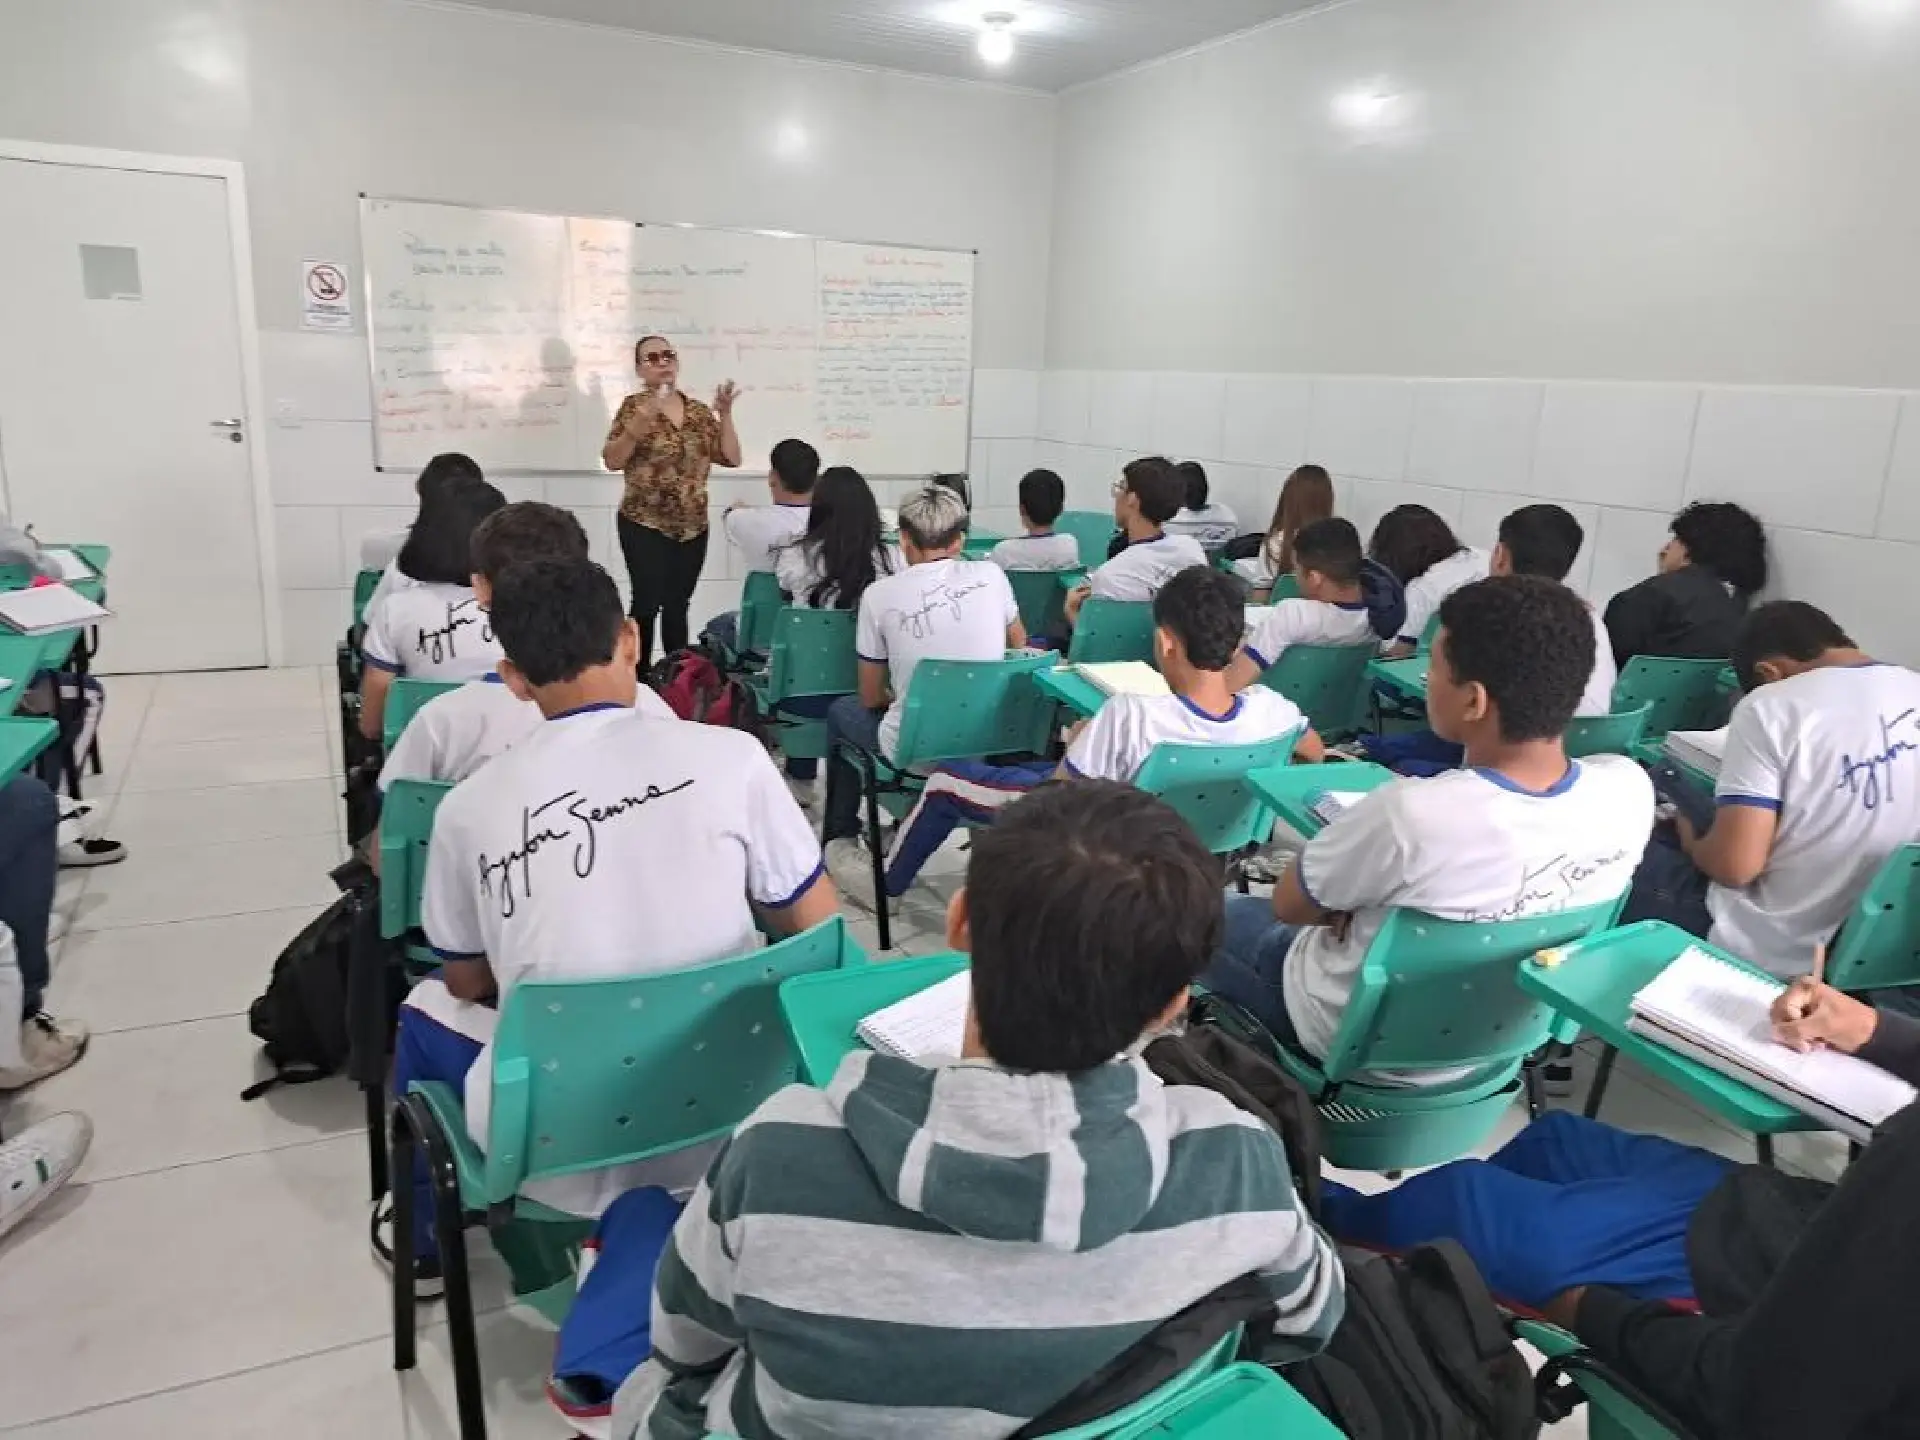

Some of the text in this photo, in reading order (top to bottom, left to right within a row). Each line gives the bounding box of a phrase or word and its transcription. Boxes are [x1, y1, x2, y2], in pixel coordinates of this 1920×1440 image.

[414, 597, 479, 665] Ayrton
[1836, 707, 1918, 811] Ayrton
[478, 778, 696, 919] Ayrton Senna
[1463, 853, 1568, 922] rton
